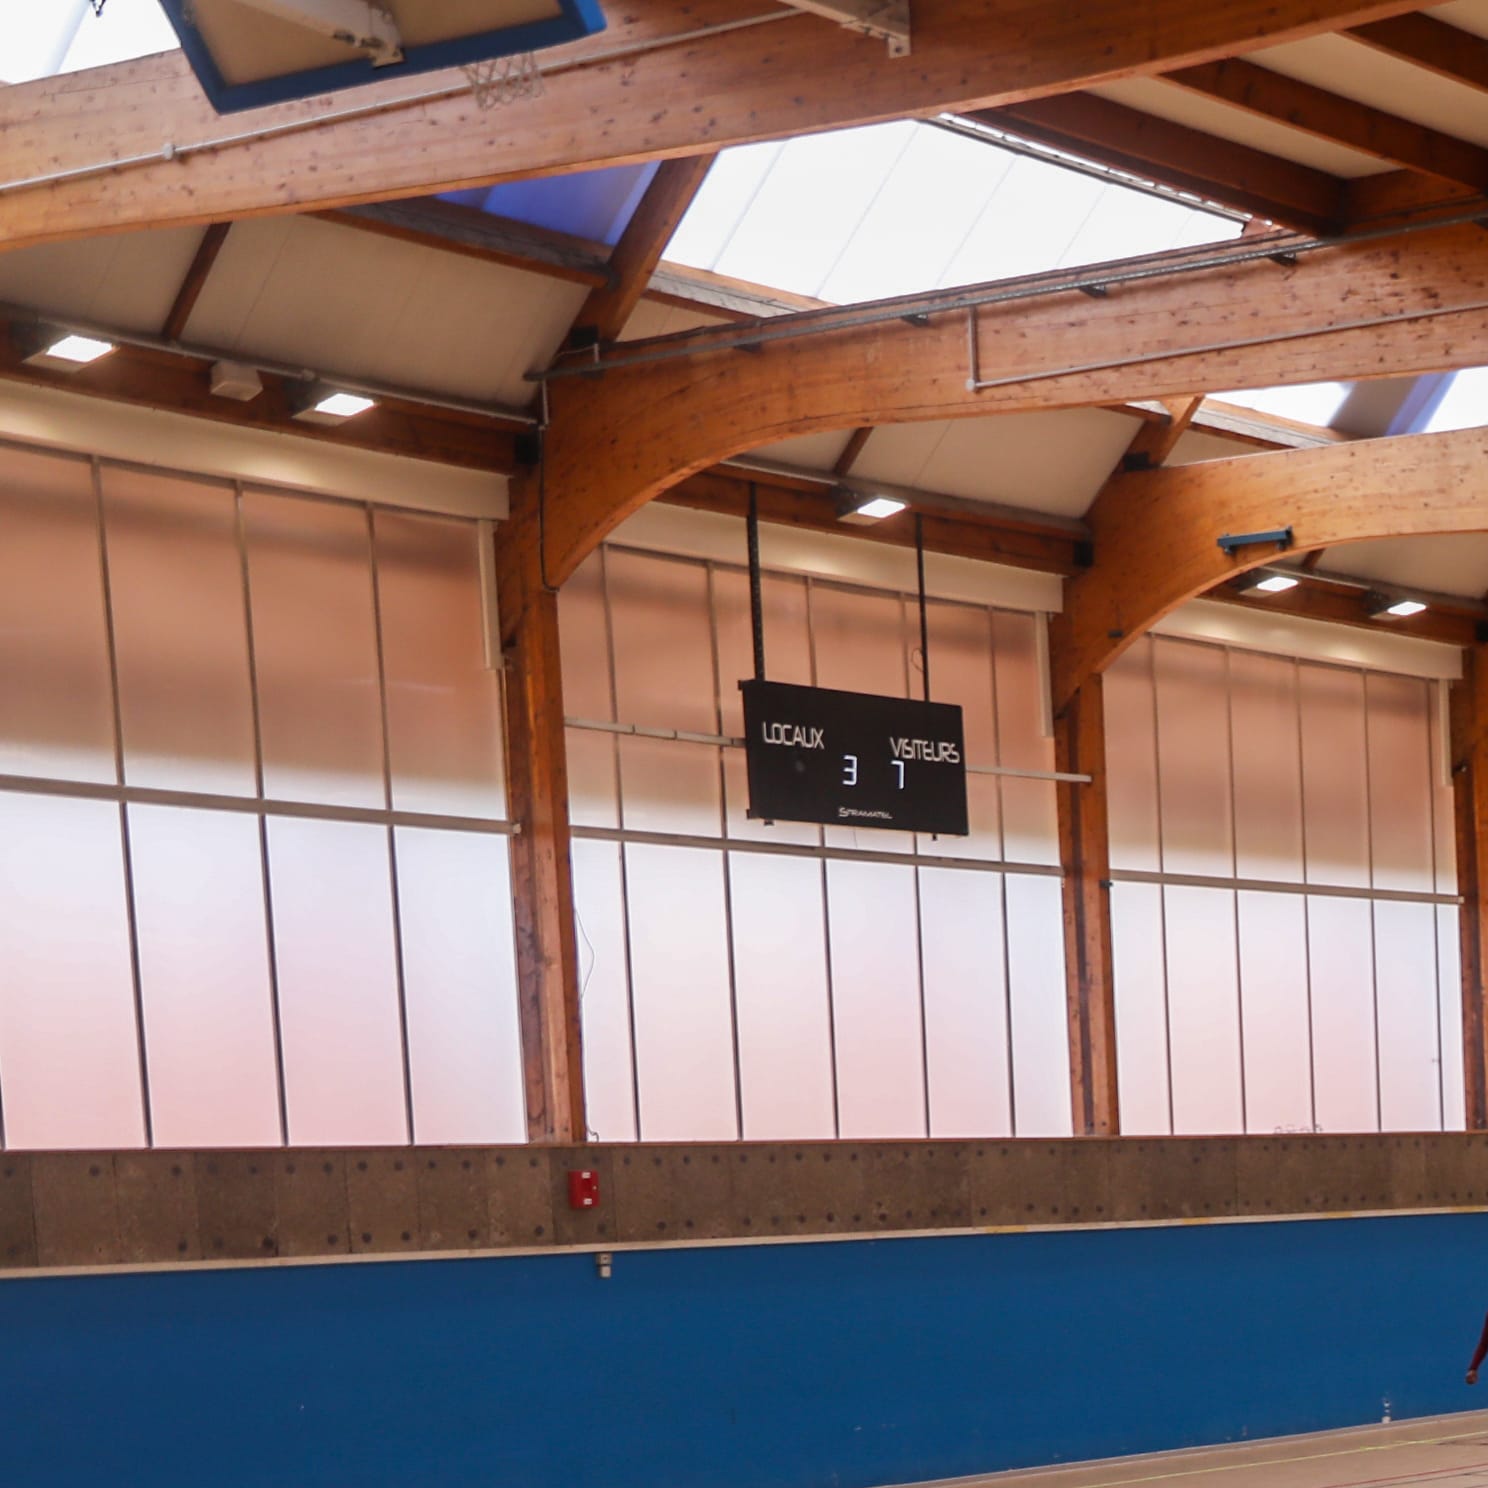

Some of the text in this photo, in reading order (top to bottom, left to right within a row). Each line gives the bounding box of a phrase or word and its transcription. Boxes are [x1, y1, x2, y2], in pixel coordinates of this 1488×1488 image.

[762, 721, 960, 764] LOCAUX VISITEURS
[842, 755, 905, 789] 3 7
